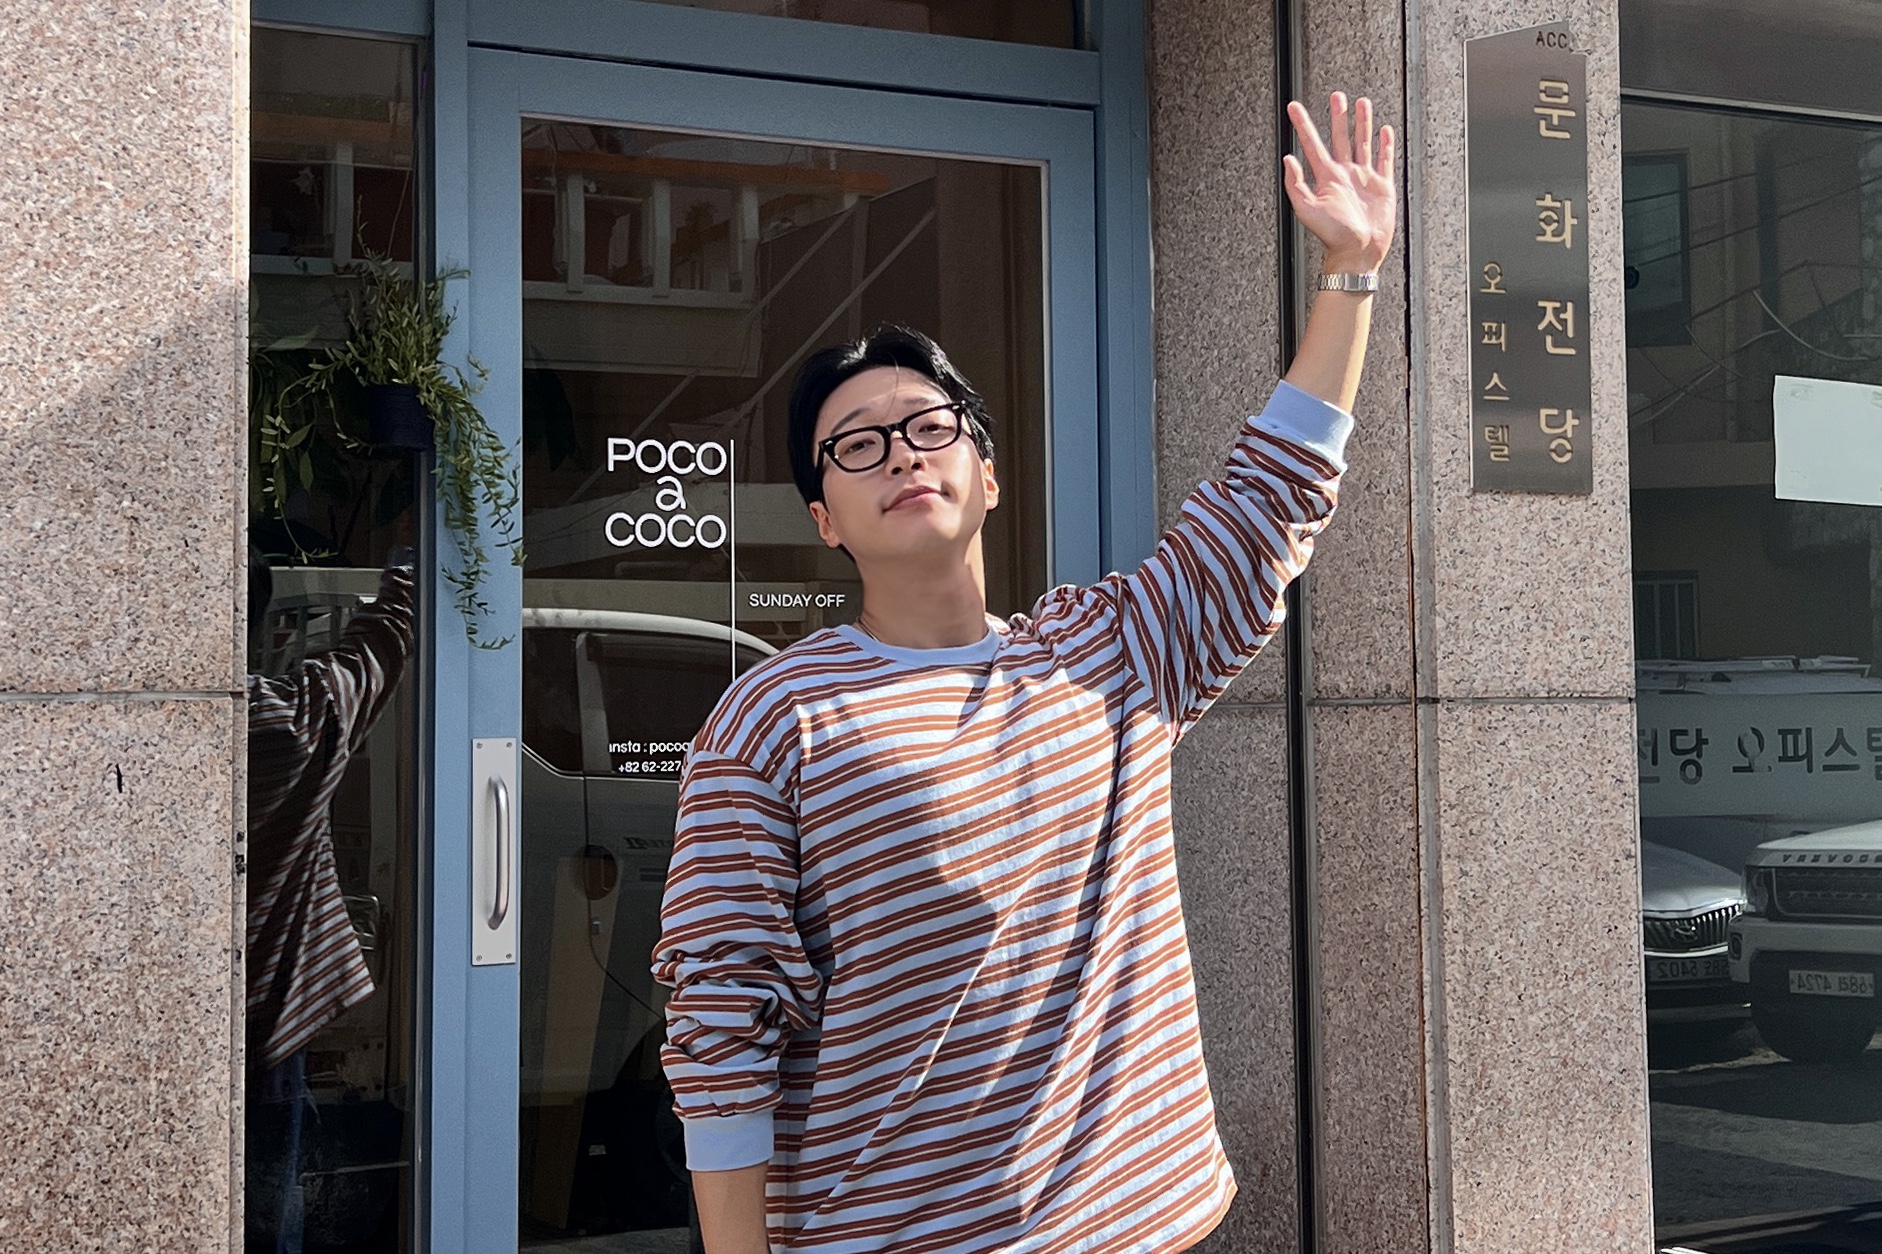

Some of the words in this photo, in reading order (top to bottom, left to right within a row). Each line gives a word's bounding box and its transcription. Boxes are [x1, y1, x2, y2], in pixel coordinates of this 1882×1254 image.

[1536, 31, 1568, 49] ACC
[1533, 78, 1578, 464] 문화전당
[607, 437, 727, 476] POCO
[655, 475, 687, 512] a
[604, 512, 727, 549] COCO
[749, 593, 812, 608] SUNDAY
[814, 593, 846, 608] OFF
[618, 761, 640, 773] +82
